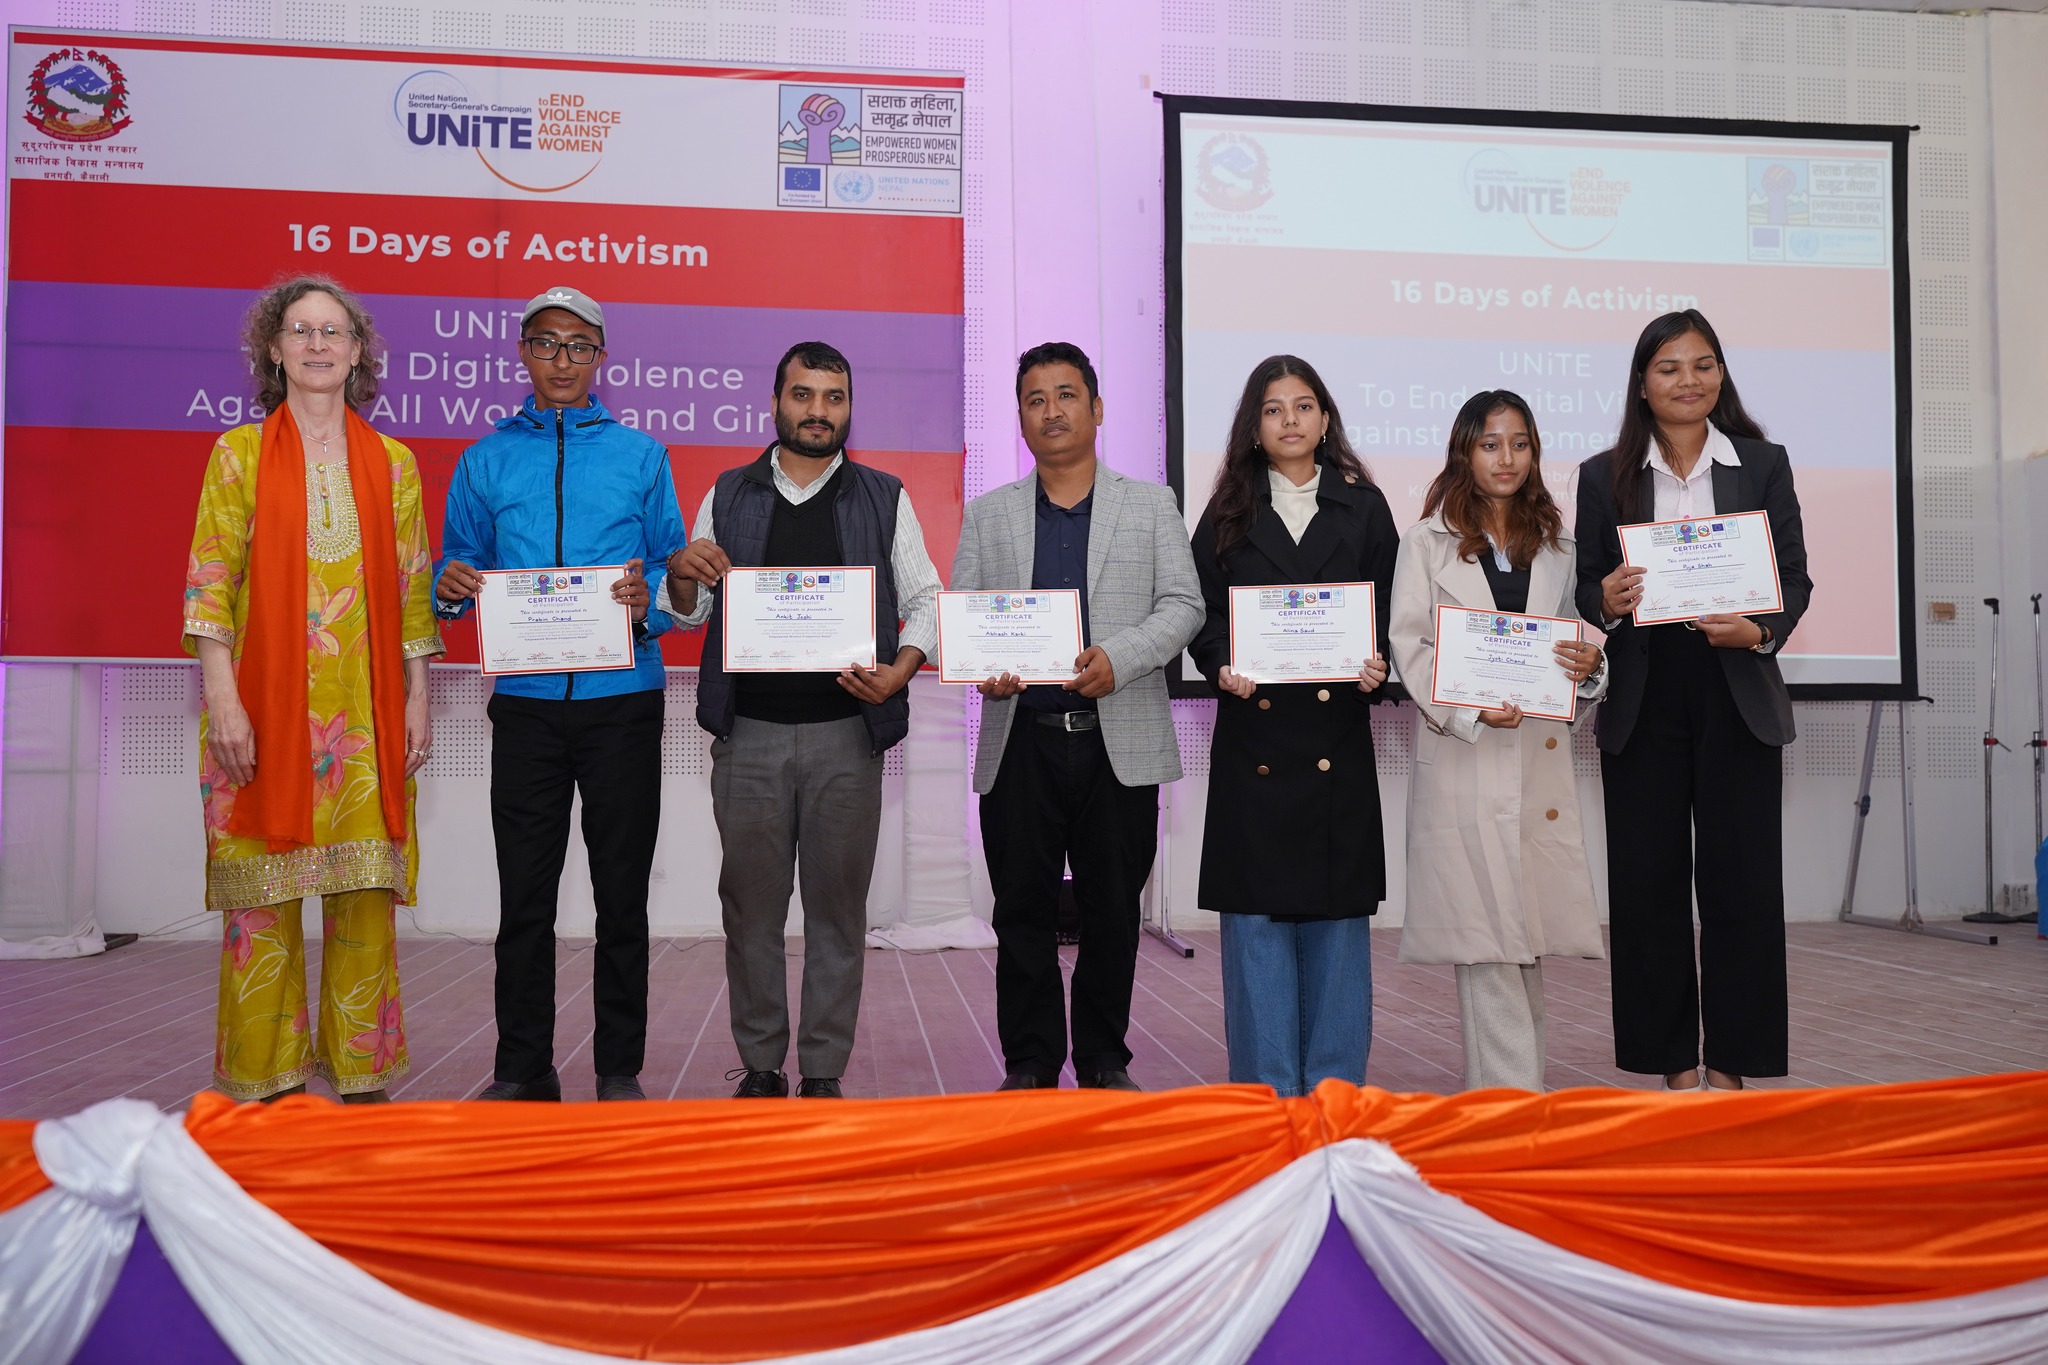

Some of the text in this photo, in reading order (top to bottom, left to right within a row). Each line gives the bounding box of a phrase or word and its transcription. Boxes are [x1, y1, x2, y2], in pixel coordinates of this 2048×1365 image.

[408, 93, 468, 102] United Nations
[538, 93, 585, 108] to END
[867, 94, 907, 109] सशक्त
[490, 104, 532, 114] Campaign
[538, 108, 622, 124] VIOLENCE
[911, 110, 953, 128] नेपाल
[407, 112, 532, 150] UNiTE
[538, 122, 611, 138] AGAINST
[538, 137, 603, 153] WOMEN
[865, 135, 957, 152] EMPOWERED WOMEN
[14, 154, 61, 166] सामाजिक
[66, 156, 98, 168] विकास
[865, 150, 957, 166] PROSPEROUS NEPAL
[1578, 167, 1604, 179] END
[878, 176, 950, 186] UNITED NATIONS
[1569, 180, 1632, 193] VIOLENCE
[878, 185, 904, 194] NEPAL
[1474, 184, 1566, 216] UNiTE
[1570, 192, 1624, 205] AGAINST
[1570, 205, 1619, 217] WOMEN
[288, 223, 709, 268] 16 Days of Activism
[1390, 280, 1699, 312] 16 Days of Activism
[1499, 351, 1592, 378] UNiTE
[1358, 383, 1396, 408] To
[368, 393, 422, 424] All
[620, 402, 695, 432] and
[713, 404, 771, 434] Gir
[1345, 420, 1442, 449] gainst
[1672, 542, 1722, 552] CERTIFICATE
[527, 596, 578, 604] CERTIFICATE
[1484, 636, 1531, 647] CERTIFICATE
